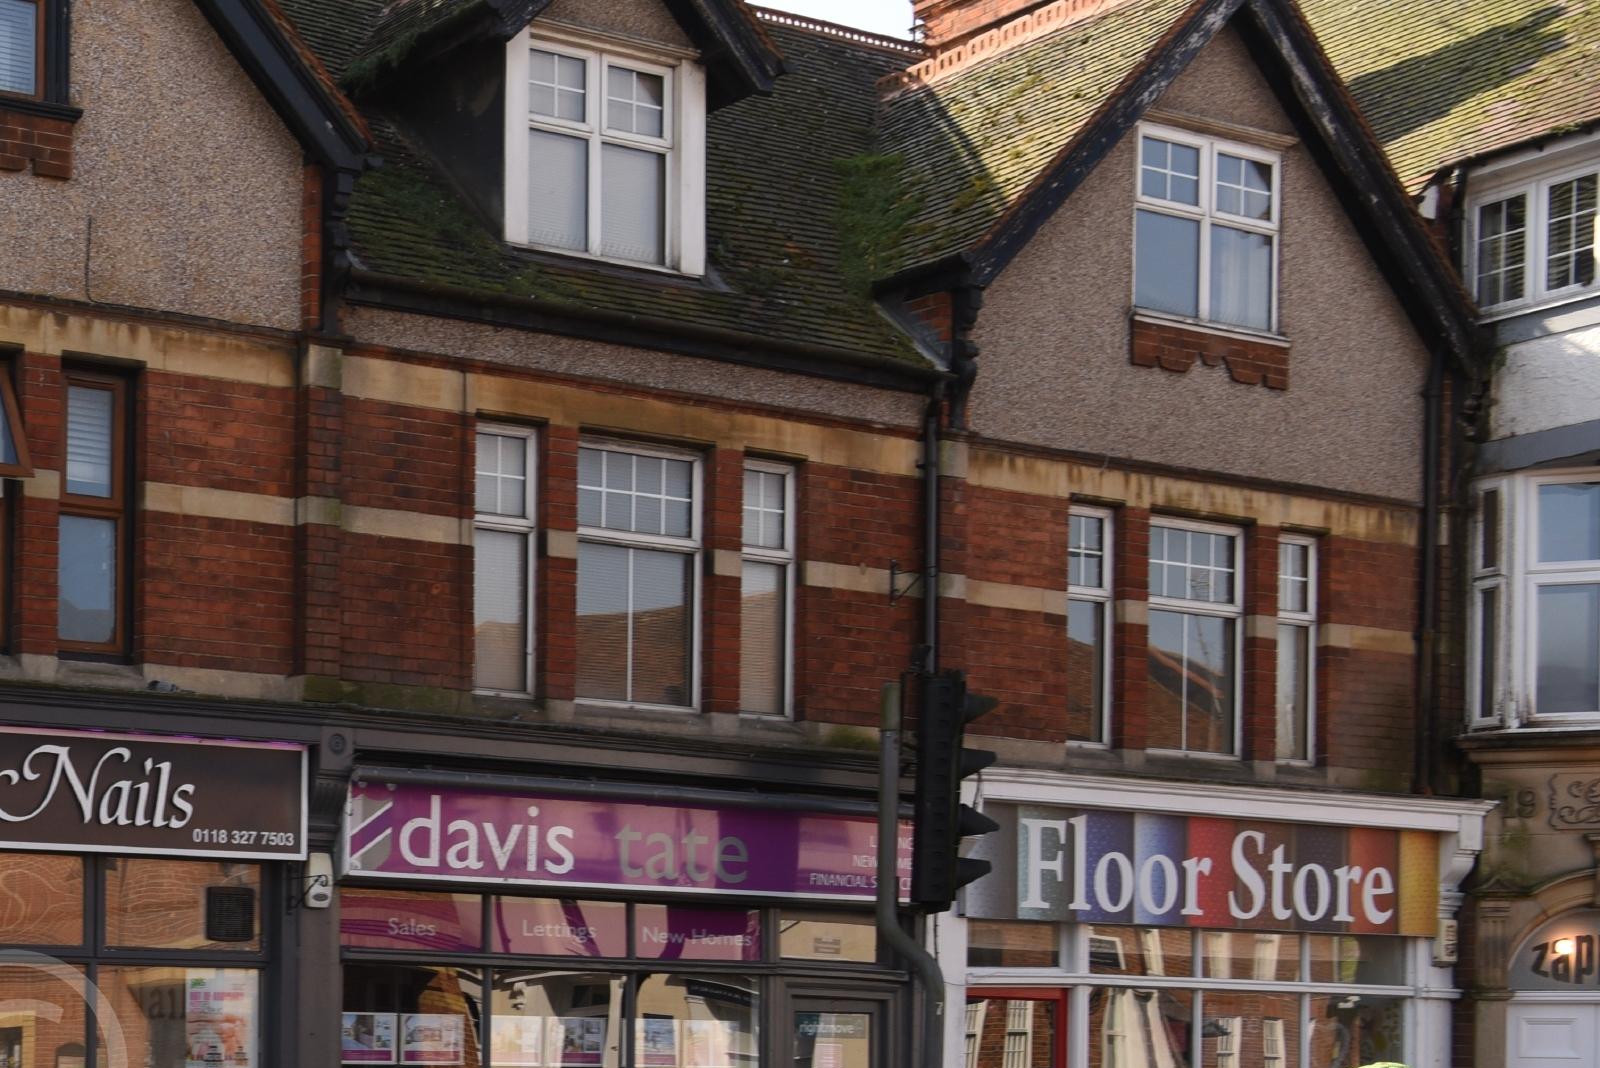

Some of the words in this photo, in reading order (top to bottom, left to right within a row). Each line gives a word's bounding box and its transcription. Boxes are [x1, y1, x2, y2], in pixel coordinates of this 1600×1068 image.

[192, 828, 228, 844] 0118
[230, 830, 258, 845] 327
[260, 831, 295, 847] 7503
[399, 794, 575, 875] davis
[614, 823, 750, 884] tate
[810, 872, 870, 888] FINANCIAL
[1019, 814, 1214, 917] Floor
[1227, 829, 1395, 925] Store
[387, 917, 437, 937] Sales
[522, 919, 598, 944] Lettings
[642, 926, 685, 946] New
[692, 928, 753, 948] Homes
[1531, 934, 1600, 985] zap
